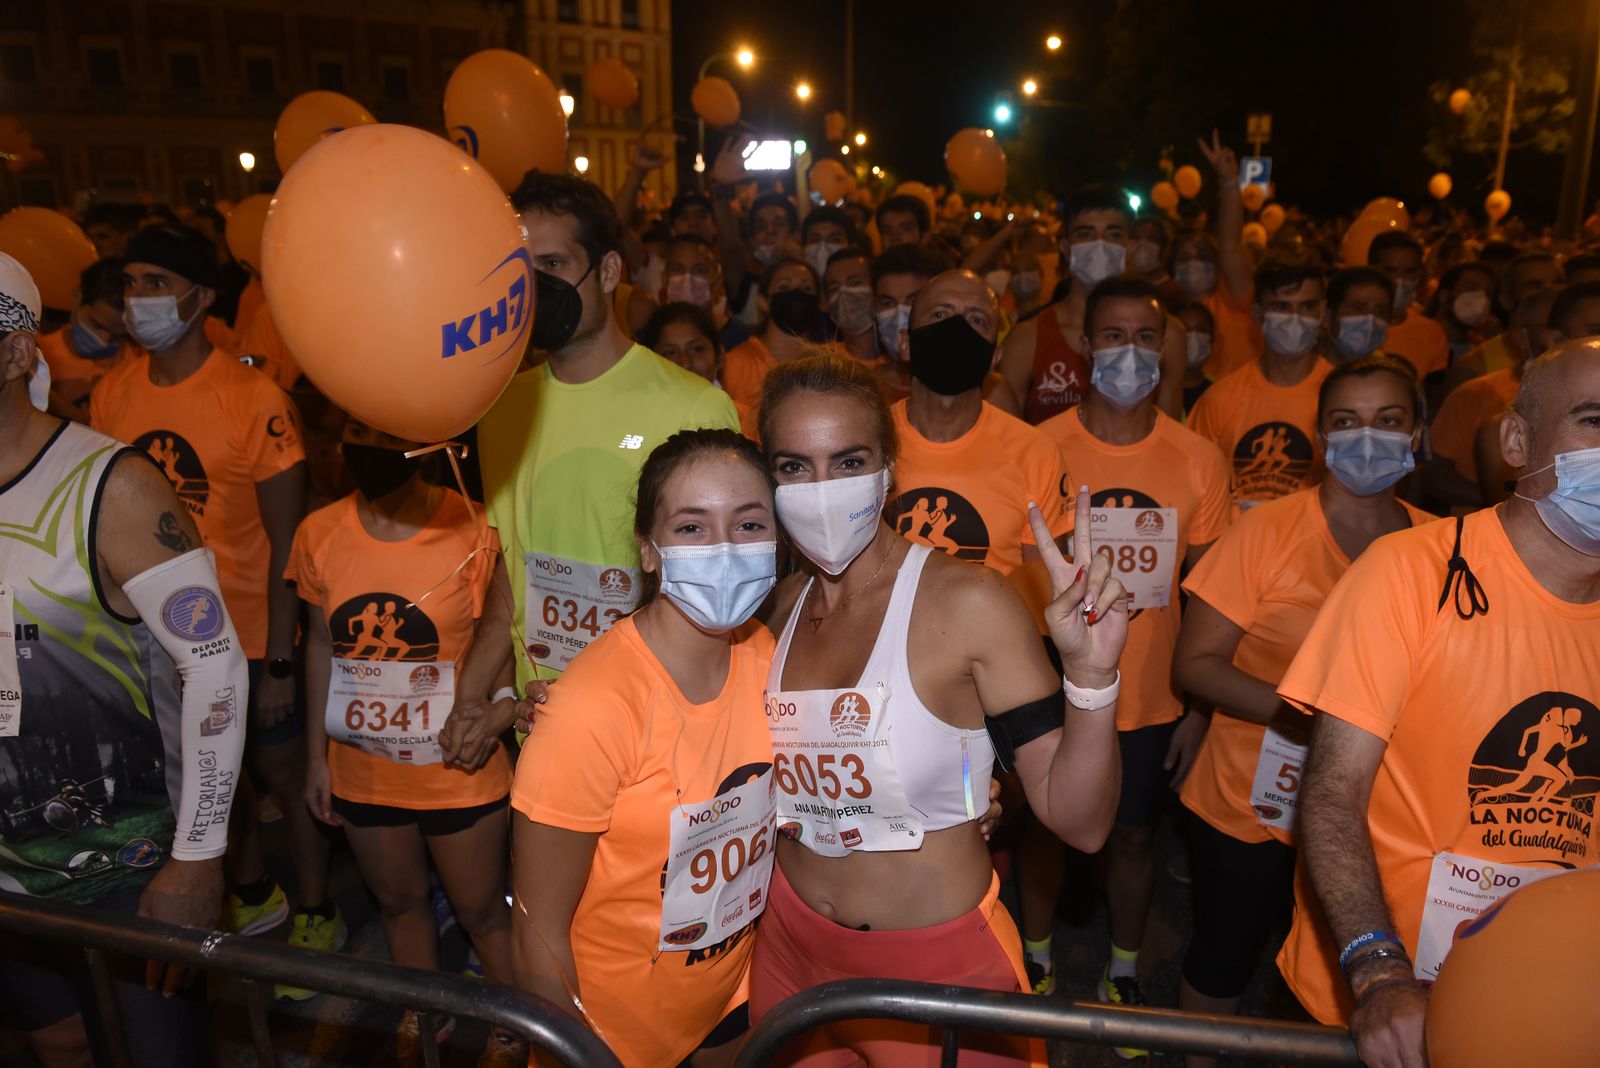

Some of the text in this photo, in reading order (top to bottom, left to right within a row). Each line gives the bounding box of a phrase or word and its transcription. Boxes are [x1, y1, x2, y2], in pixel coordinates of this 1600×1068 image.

[1245, 159, 1264, 184] P
[537, 629, 564, 644] VICENTE
[191, 637, 231, 654] DEPORTE
[200, 645, 231, 659] MANIA
[345, 700, 430, 732] 6341
[399, 735, 433, 745] SECILLA
[821, 741, 859, 749] GUADALQUIVIR
[774, 752, 872, 800] 6053
[212, 770, 234, 824] DE PILAS
[794, 803, 811, 814] ANA
[836, 805, 874, 819] PEREZ
[1470, 808, 1499, 825] LA
[692, 837, 717, 850] CARRERA
[717, 826, 749, 839] NOCTURNA
[1482, 829, 1506, 847] del
[1448, 886, 1488, 900] AYUNTAMIENTO
[1433, 897, 1455, 909] XXXIII
